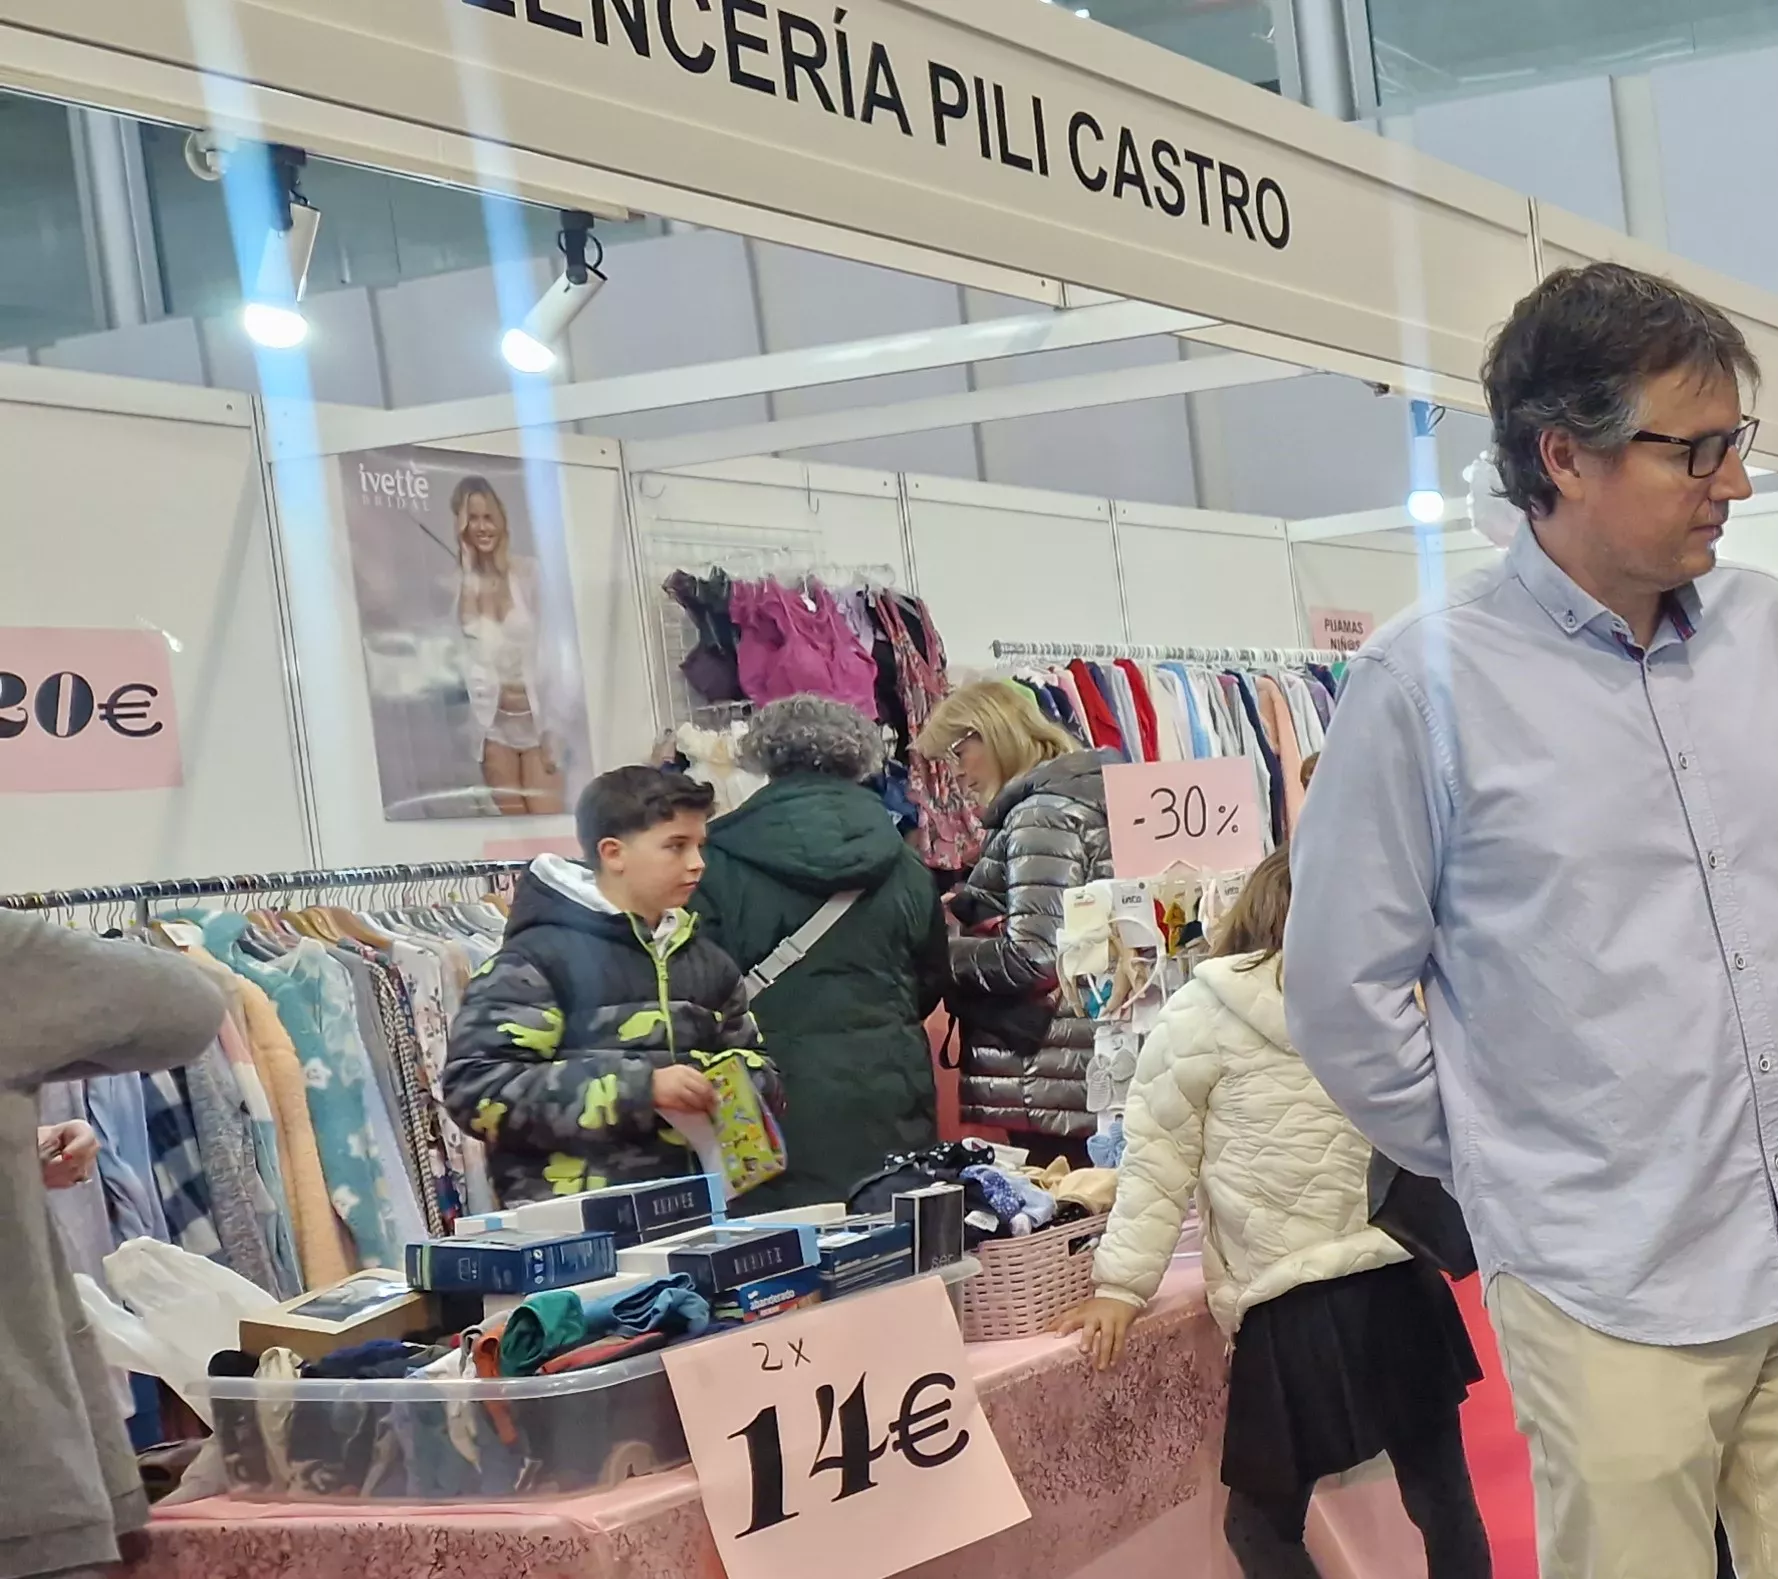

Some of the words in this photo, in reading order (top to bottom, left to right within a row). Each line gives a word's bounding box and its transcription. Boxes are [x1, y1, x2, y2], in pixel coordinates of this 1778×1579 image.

[928, 60, 1049, 177] PILI
[1068, 111, 1290, 250] CASTRO
[727, 1371, 970, 1540] 14€
